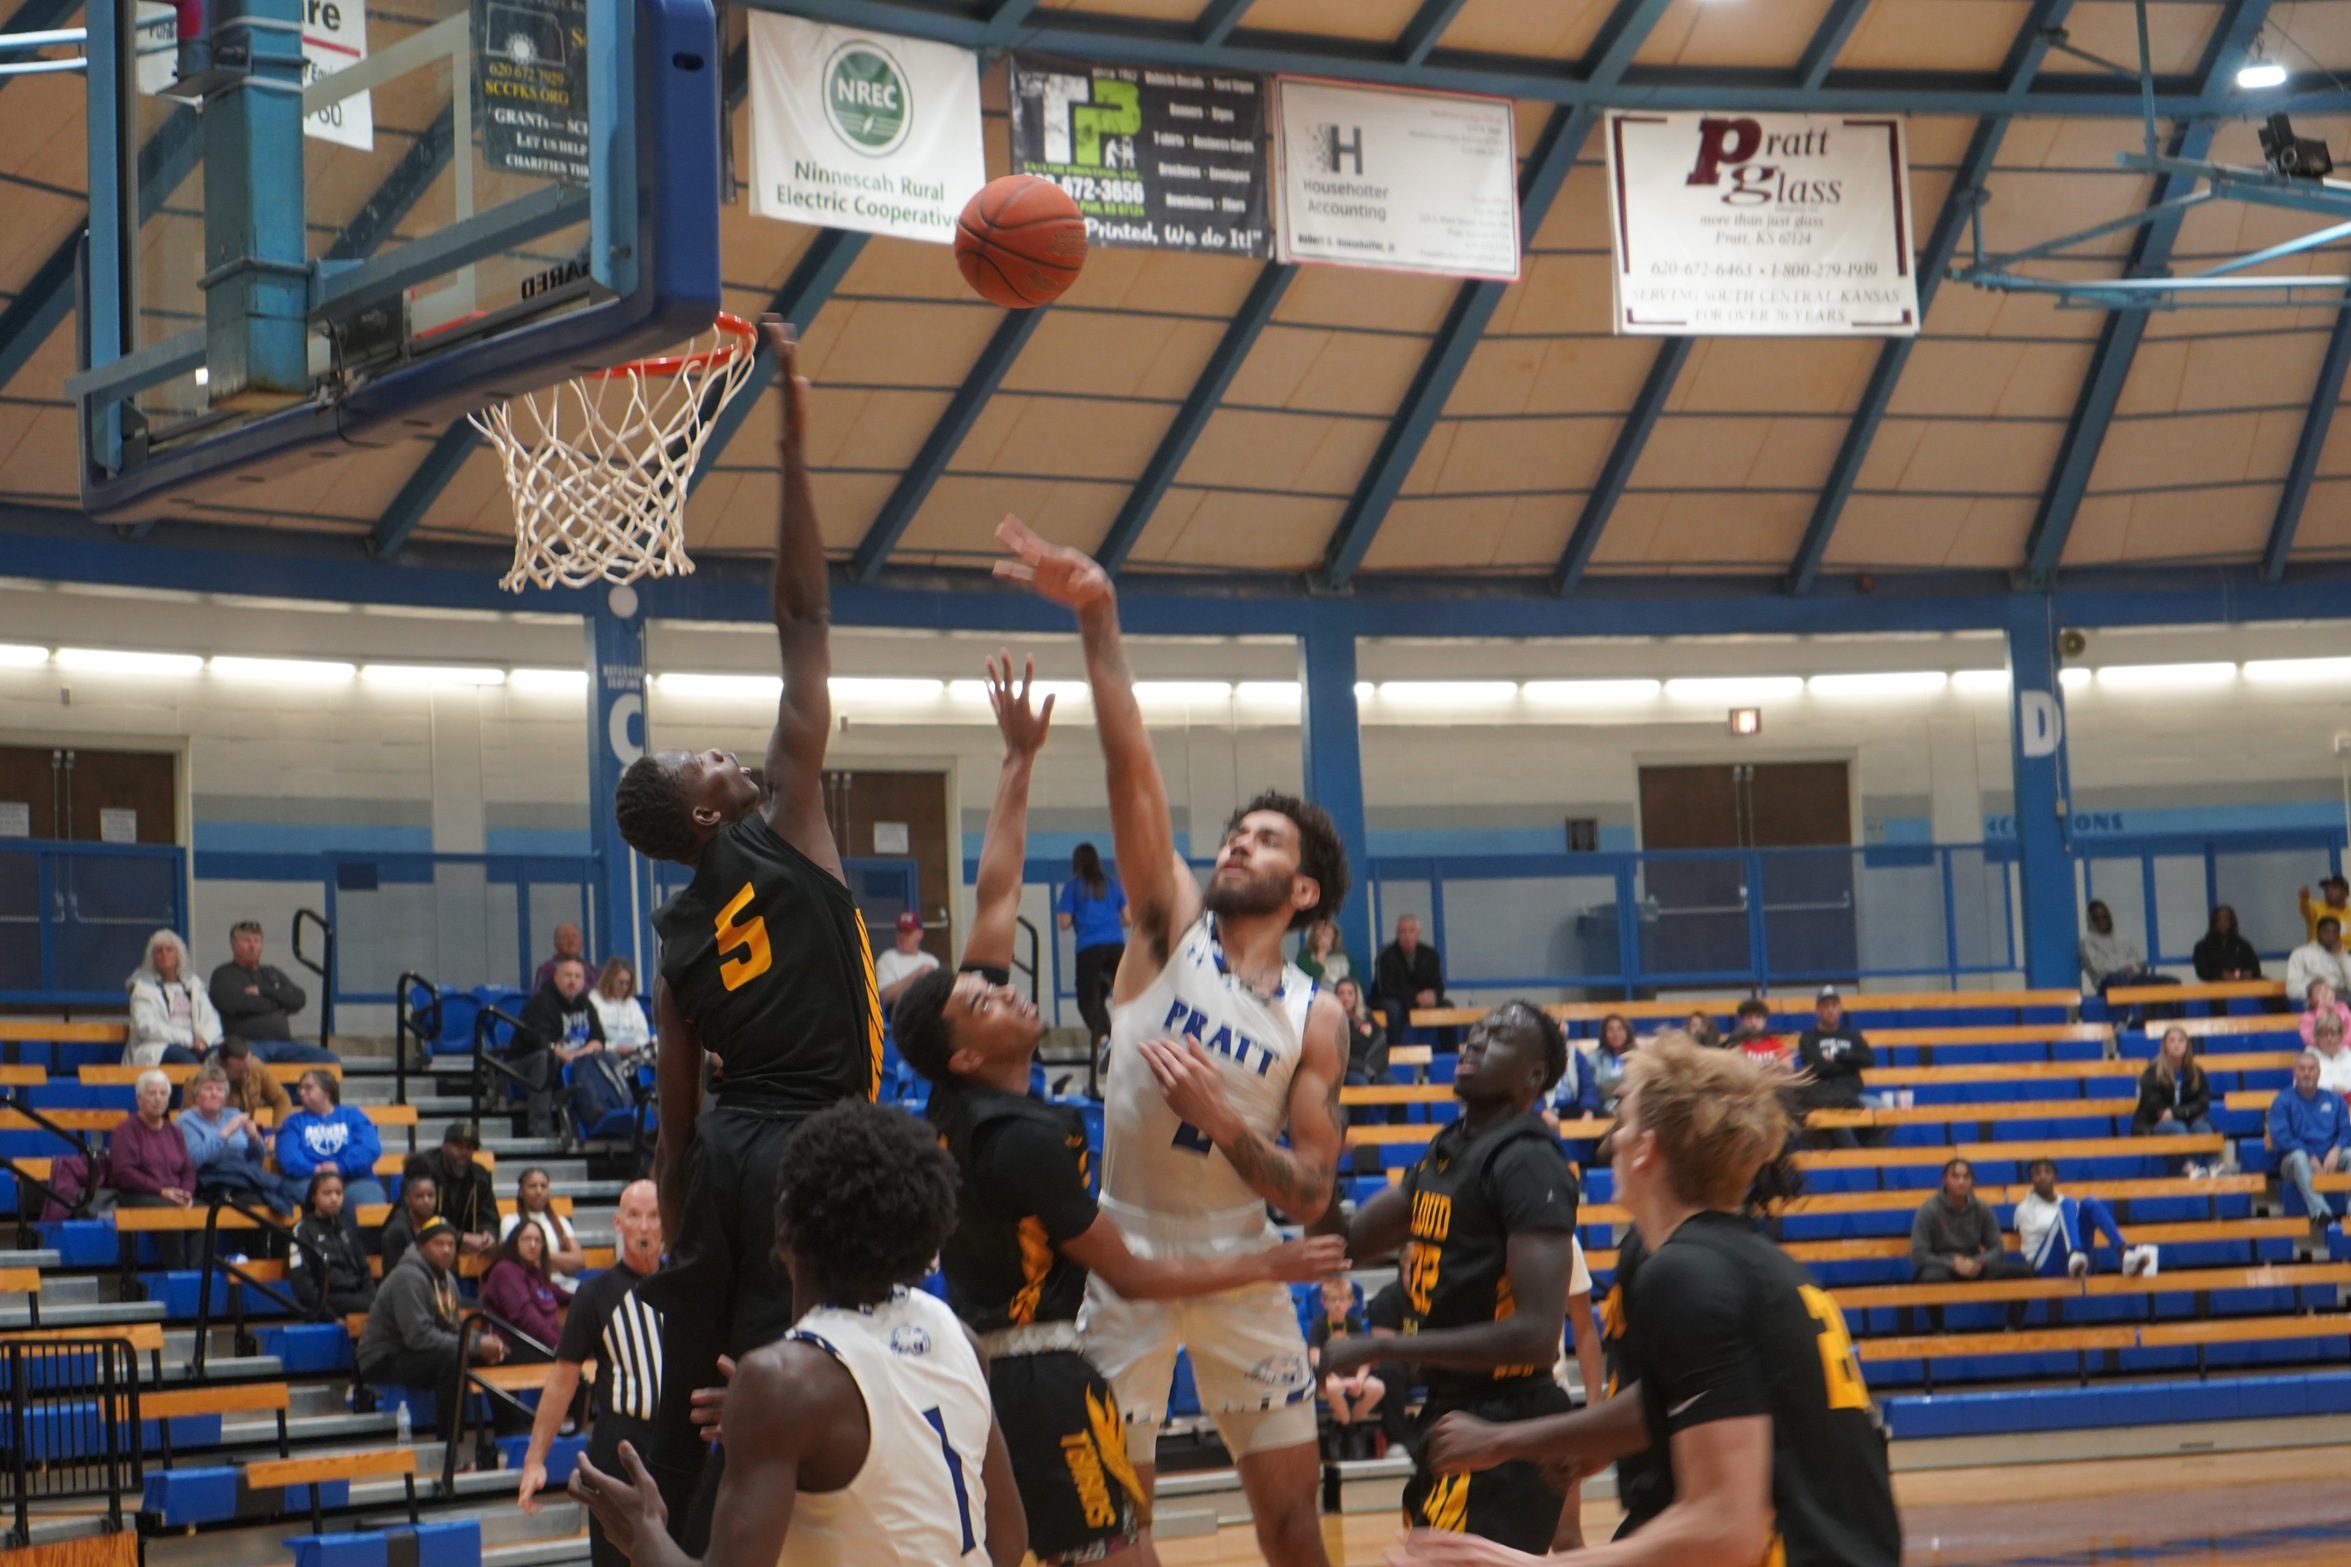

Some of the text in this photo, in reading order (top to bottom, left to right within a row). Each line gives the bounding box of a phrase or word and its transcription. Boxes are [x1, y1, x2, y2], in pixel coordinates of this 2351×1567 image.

[837, 77, 898, 110] NREC
[506, 153, 568, 174] CHARITIES
[1685, 116, 1830, 187] Pratt
[795, 159, 944, 201] Ninnescah Rural
[1721, 164, 1843, 207] glass
[776, 183, 847, 213] Electric
[1308, 200, 1387, 222] Accounting
[1085, 216, 1158, 243] Printed,
[1165, 225, 1196, 246] We
[1201, 226, 1226, 247] do
[1700, 211, 1824, 231] more than just glass
[1756, 230, 1775, 246] KS
[1632, 287, 1900, 304] SERVING SOUTH CENTRAL KANSAS
[1695, 308, 1723, 322] FOR
[1728, 308, 1768, 322] OVER
[1794, 309, 1845, 323] YEARS
[609, 692, 644, 766] C
[2020, 690, 2063, 758] D
[714, 881, 772, 991] 5
[1163, 995, 1280, 1077] PRATT
[922, 1404, 977, 1558] 1
